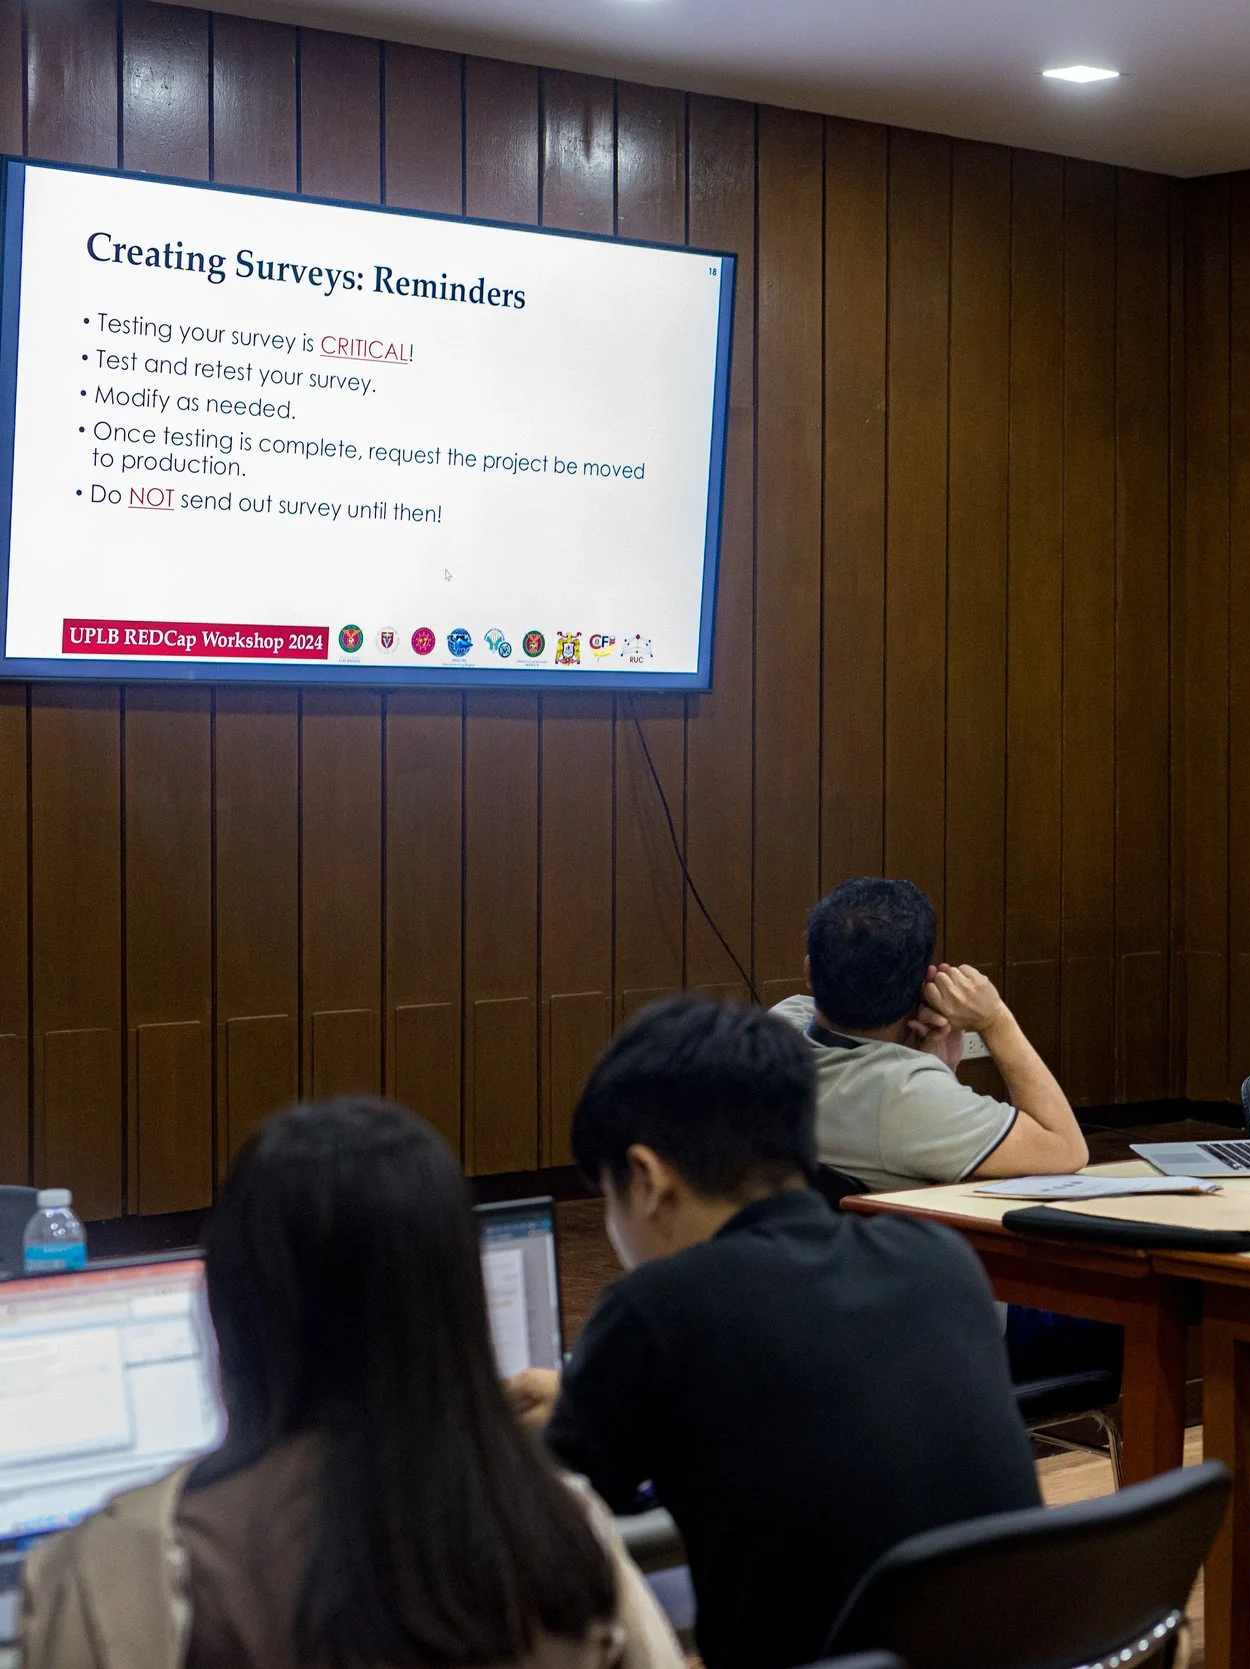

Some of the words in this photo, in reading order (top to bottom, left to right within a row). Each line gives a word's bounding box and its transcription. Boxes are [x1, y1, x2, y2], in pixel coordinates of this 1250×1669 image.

[86, 231, 227, 285] Creating
[235, 249, 364, 298] Surveys:
[372, 265, 526, 310] Reminders
[709, 267, 717, 276] 18
[97, 312, 173, 344] Testing
[179, 325, 226, 345] your
[231, 330, 297, 355] survey
[302, 332, 314, 353] is
[319, 335, 414, 364] CRITICAL!
[95, 348, 138, 372] Test
[144, 356, 188, 376] and
[194, 359, 253, 382] retest
[258, 368, 304, 388] your
[308, 373, 377, 397] survey.
[94, 384, 171, 414] Modify
[176, 395, 200, 412] as
[206, 397, 296, 420] needed.
[91, 447, 114, 468] to
[121, 452, 246, 477] production.
[93, 420, 156, 445] Once
[163, 425, 233, 455] testing
[239, 432, 252, 452] is
[258, 437, 363, 462] complete,
[368, 446, 442, 467] request
[447, 447, 477, 468] the
[482, 454, 549, 475] project
[553, 455, 578, 475] be
[583, 462, 646, 480] moved
[90, 483, 122, 505] Do
[128, 486, 176, 511] NOT
[180, 491, 232, 511] send
[238, 494, 273, 513] out
[278, 499, 342, 522] survey
[347, 500, 387, 520] until
[393, 502, 442, 524] then!
[69, 627, 120, 645] UPLB
[123, 628, 197, 652] REDCap
[201, 631, 284, 654] Workshop
[288, 634, 323, 650] 2024
[629, 655, 644, 664] RUC
